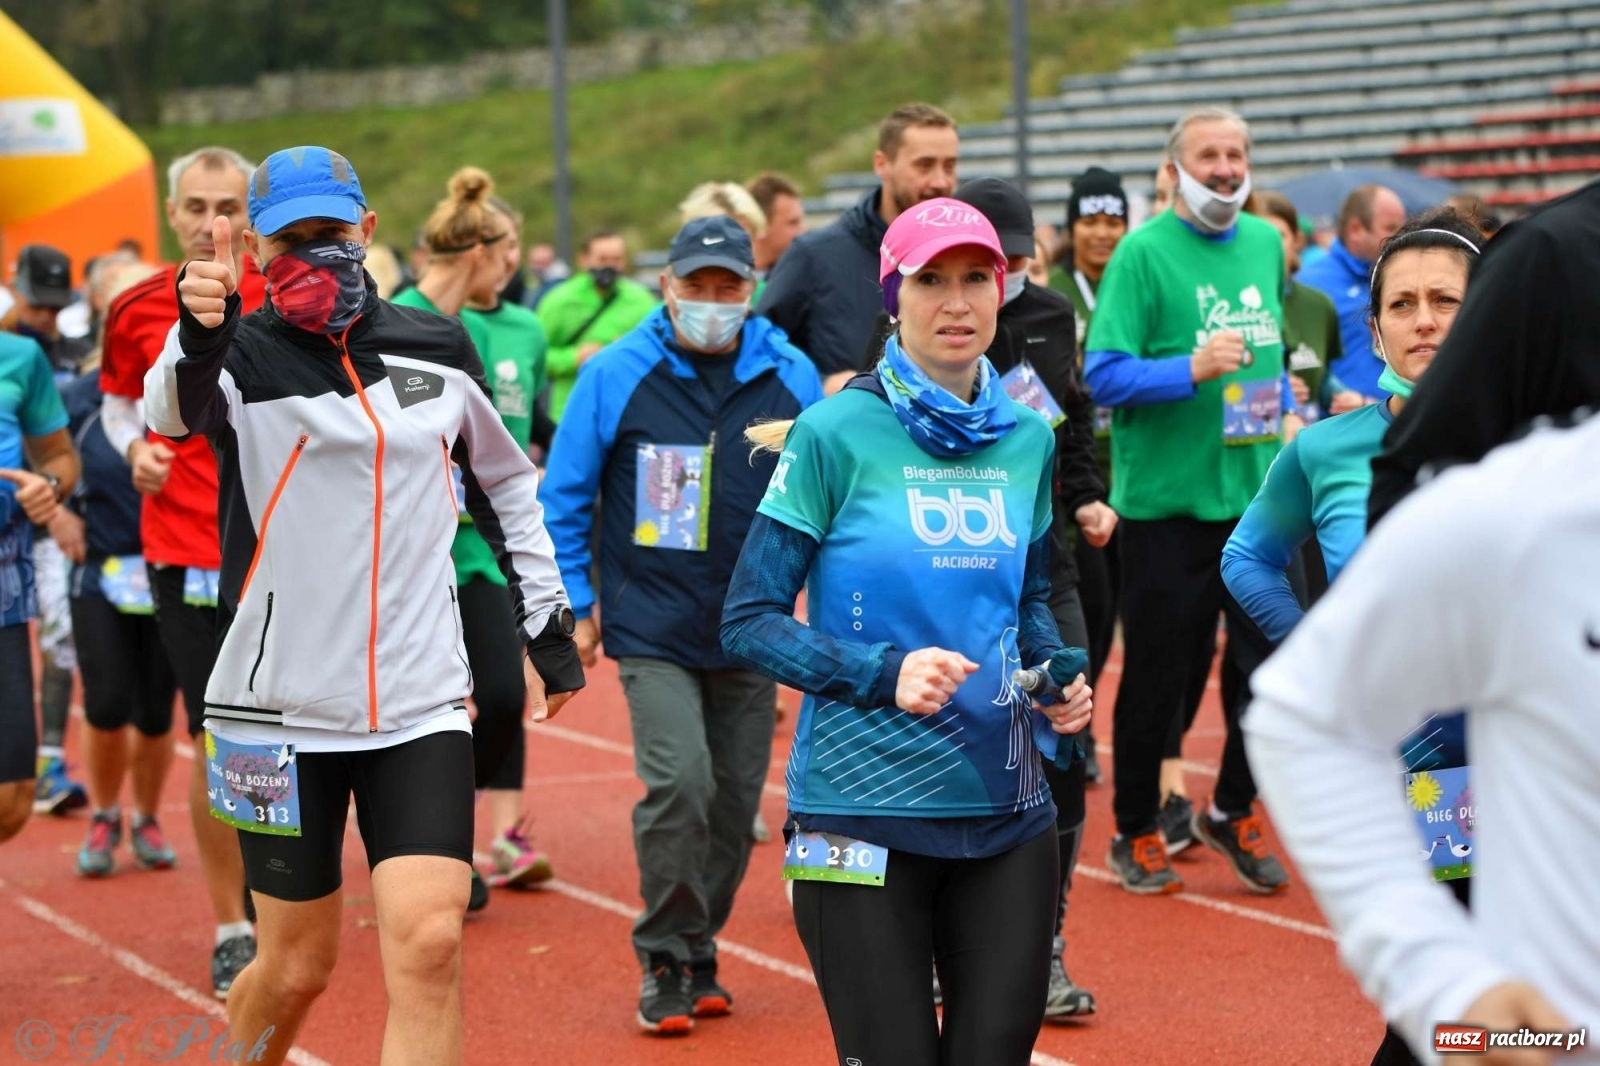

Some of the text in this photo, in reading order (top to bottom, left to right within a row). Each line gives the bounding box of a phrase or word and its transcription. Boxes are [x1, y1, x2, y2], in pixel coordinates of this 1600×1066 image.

[915, 204, 983, 229] Run
[903, 466, 1009, 482] BiegamBoLubię
[906, 488, 1018, 549] bbl
[932, 554, 998, 569] RACIBÓRZ
[226, 770, 242, 783] DLA
[254, 805, 290, 823] 313
[1426, 808, 1453, 824] BIEG
[826, 845, 873, 868] 230
